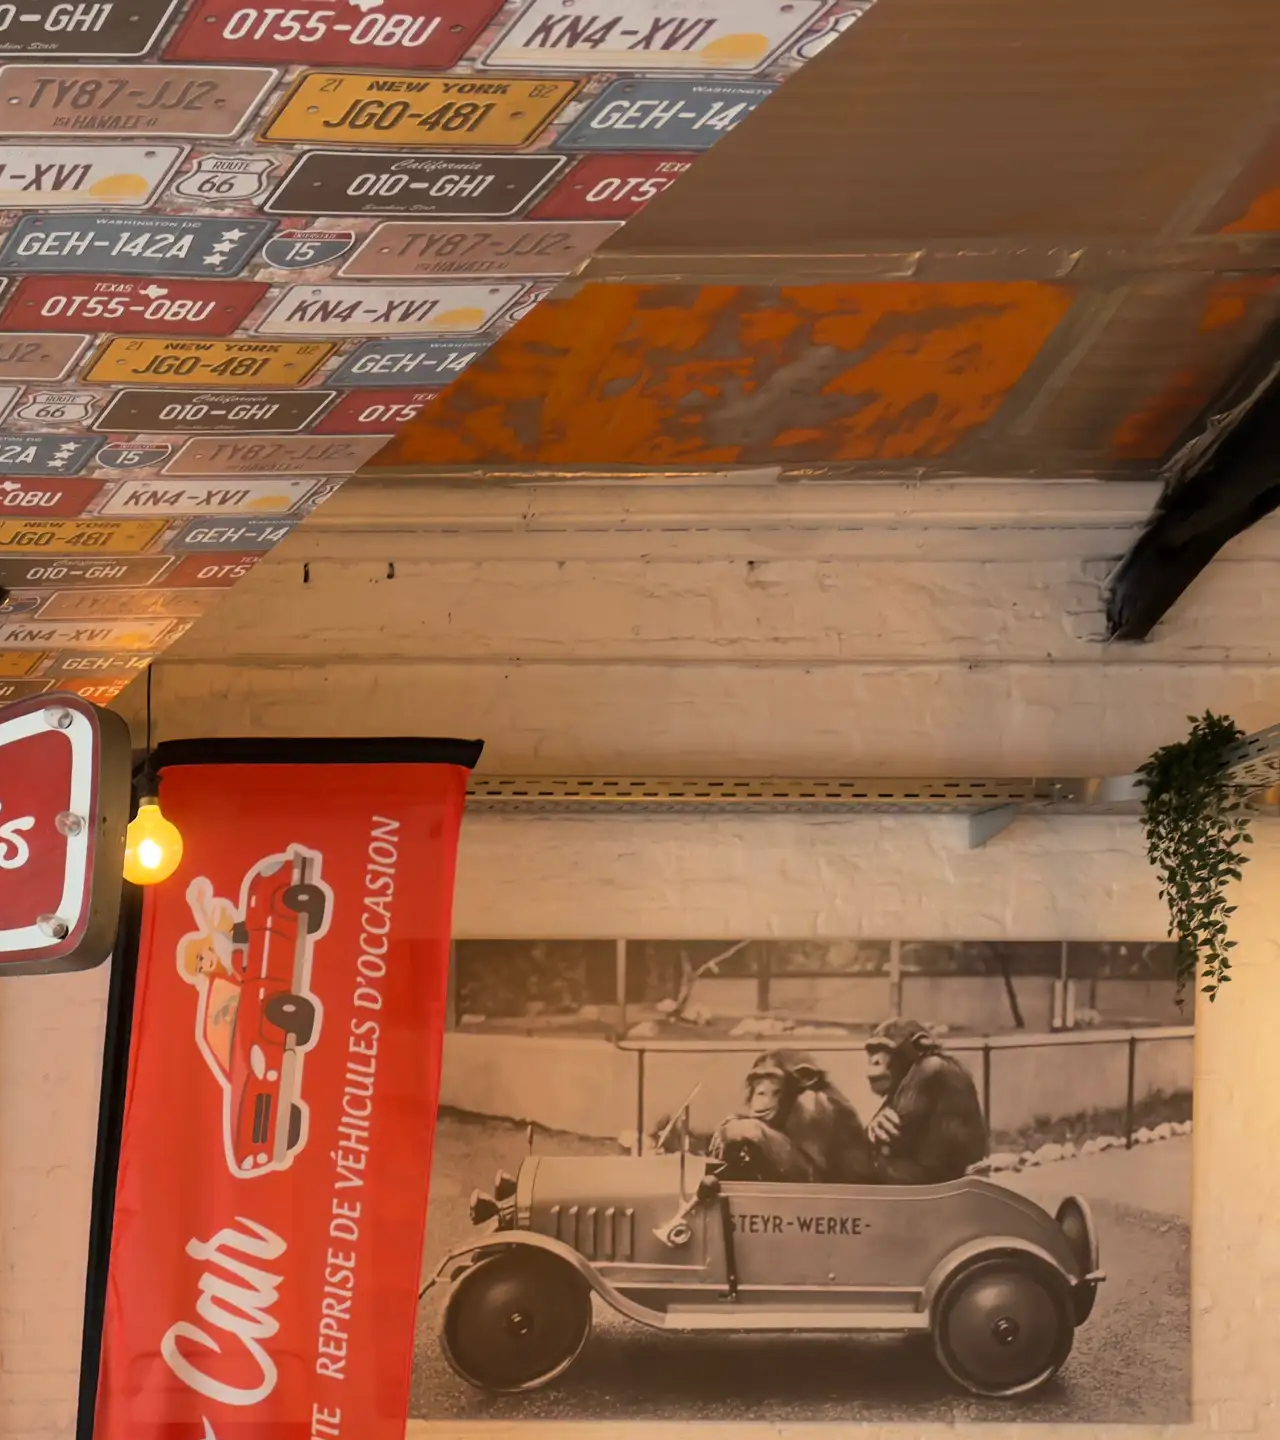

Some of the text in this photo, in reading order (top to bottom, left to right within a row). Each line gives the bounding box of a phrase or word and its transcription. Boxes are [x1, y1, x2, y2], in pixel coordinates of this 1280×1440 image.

[366, 82, 512, 94] NEW YORK
[389, 155, 483, 172] California
[194, 174, 243, 194] 66
[18, 228, 194, 260] GEH-142A
[285, 242, 321, 261] 15
[353, 815, 401, 1011] D'OCCASION
[329, 1018, 379, 1189] VÉHICULES
[329, 1198, 362, 1242] DE
[161, 1216, 287, 1406] Car
[315, 1248, 359, 1381] REPRISE
